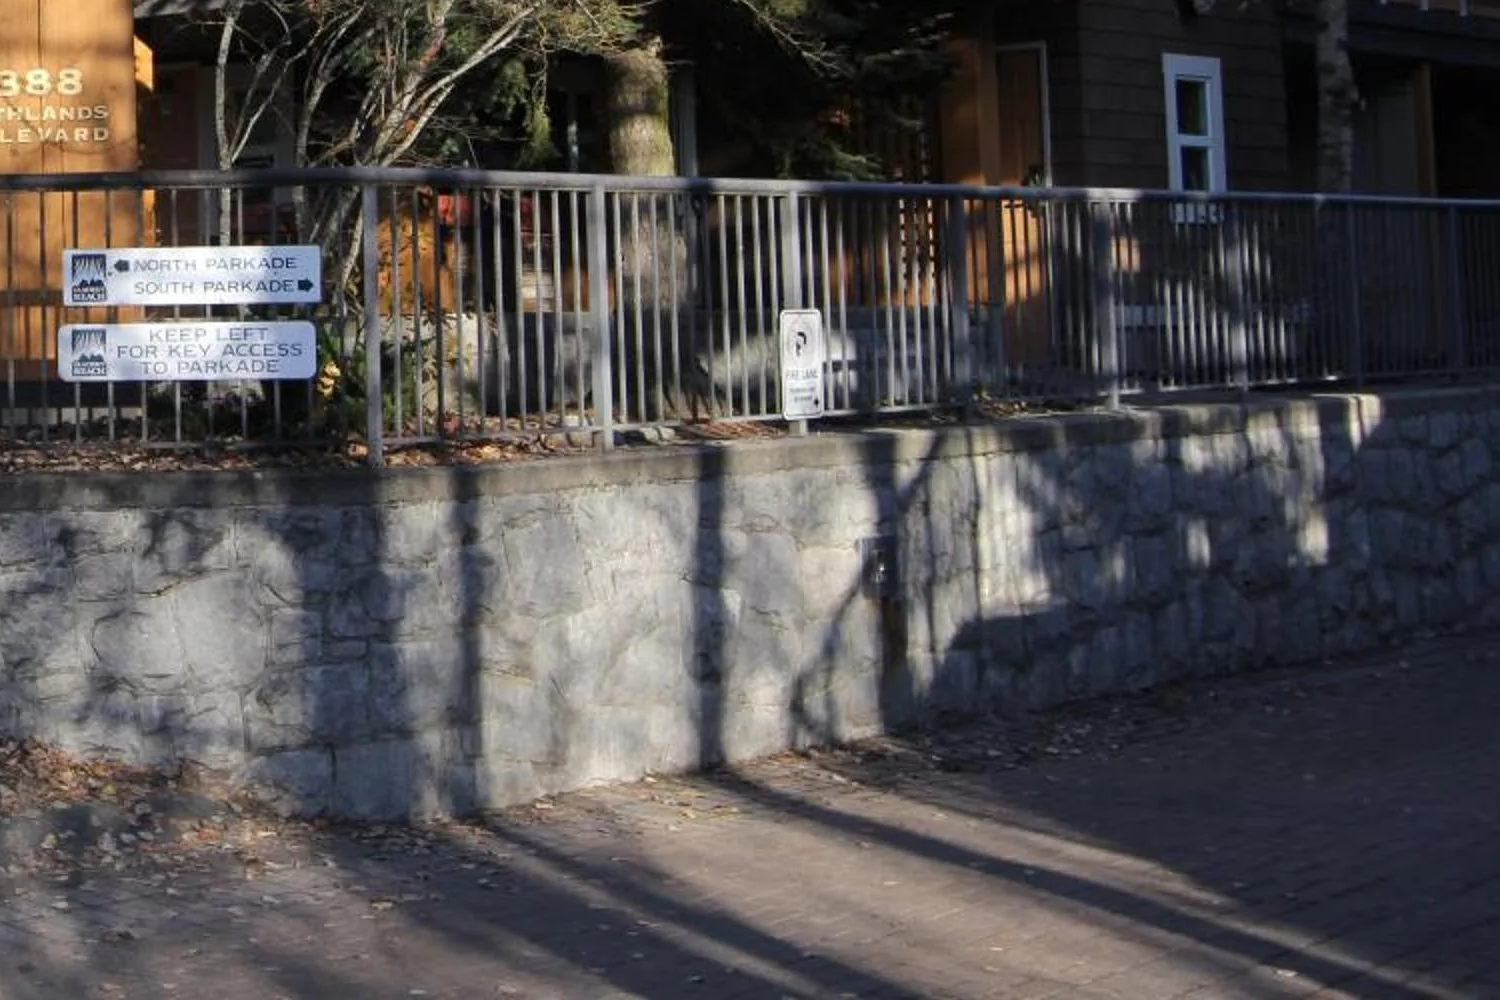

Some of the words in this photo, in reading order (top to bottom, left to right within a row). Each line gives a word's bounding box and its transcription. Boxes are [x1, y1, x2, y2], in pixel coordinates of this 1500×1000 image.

[133, 259, 197, 272] NORTH
[205, 257, 298, 271] PARKADE
[134, 282, 194, 295] SOUTH
[203, 279, 295, 293] PARKADE
[149, 328, 207, 342] KEEP
[216, 327, 269, 341] LEFT
[116, 345, 158, 358] FOR
[167, 344, 212, 357] KEY
[221, 343, 303, 357] ACCESS
[141, 361, 168, 375] TO
[177, 359, 280, 374] PARKADE
